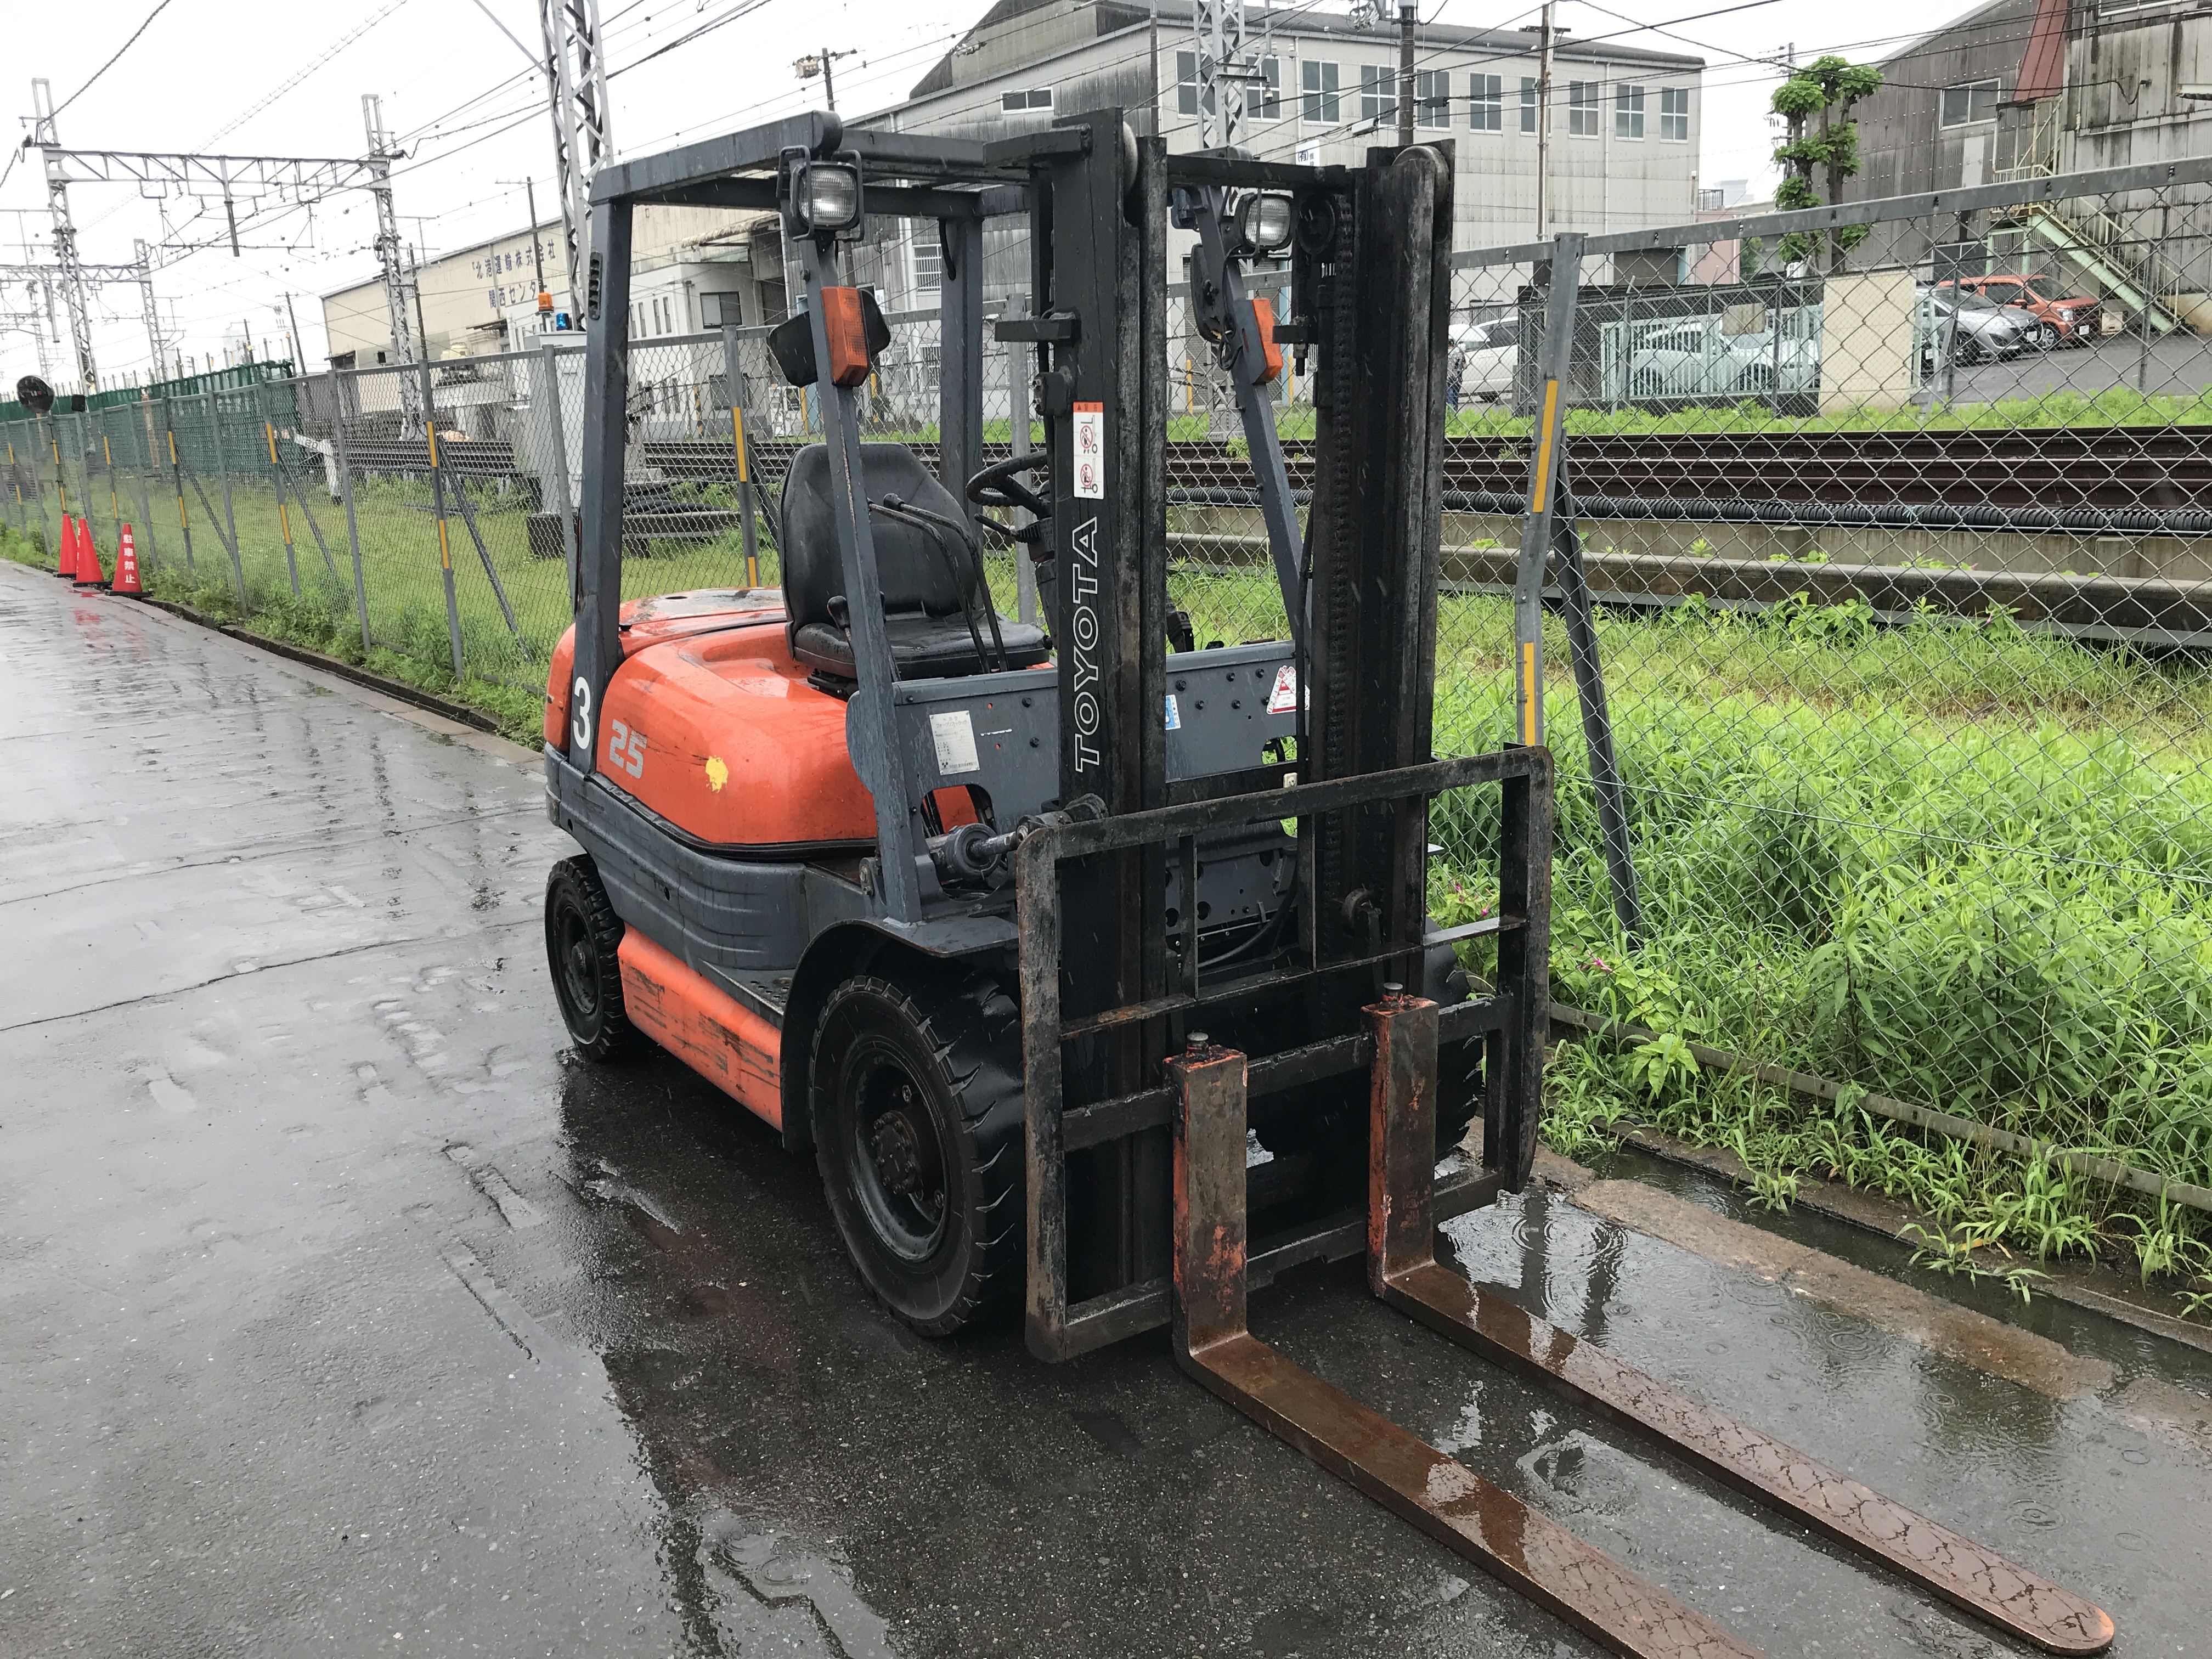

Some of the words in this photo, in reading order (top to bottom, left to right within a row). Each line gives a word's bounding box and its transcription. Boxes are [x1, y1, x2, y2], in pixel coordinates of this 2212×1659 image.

[123, 534, 136, 583] 駐車禁止
[1073, 516, 1099, 772] TOYOTA
[573, 676, 590, 749] 3
[610, 719, 647, 779] 25
